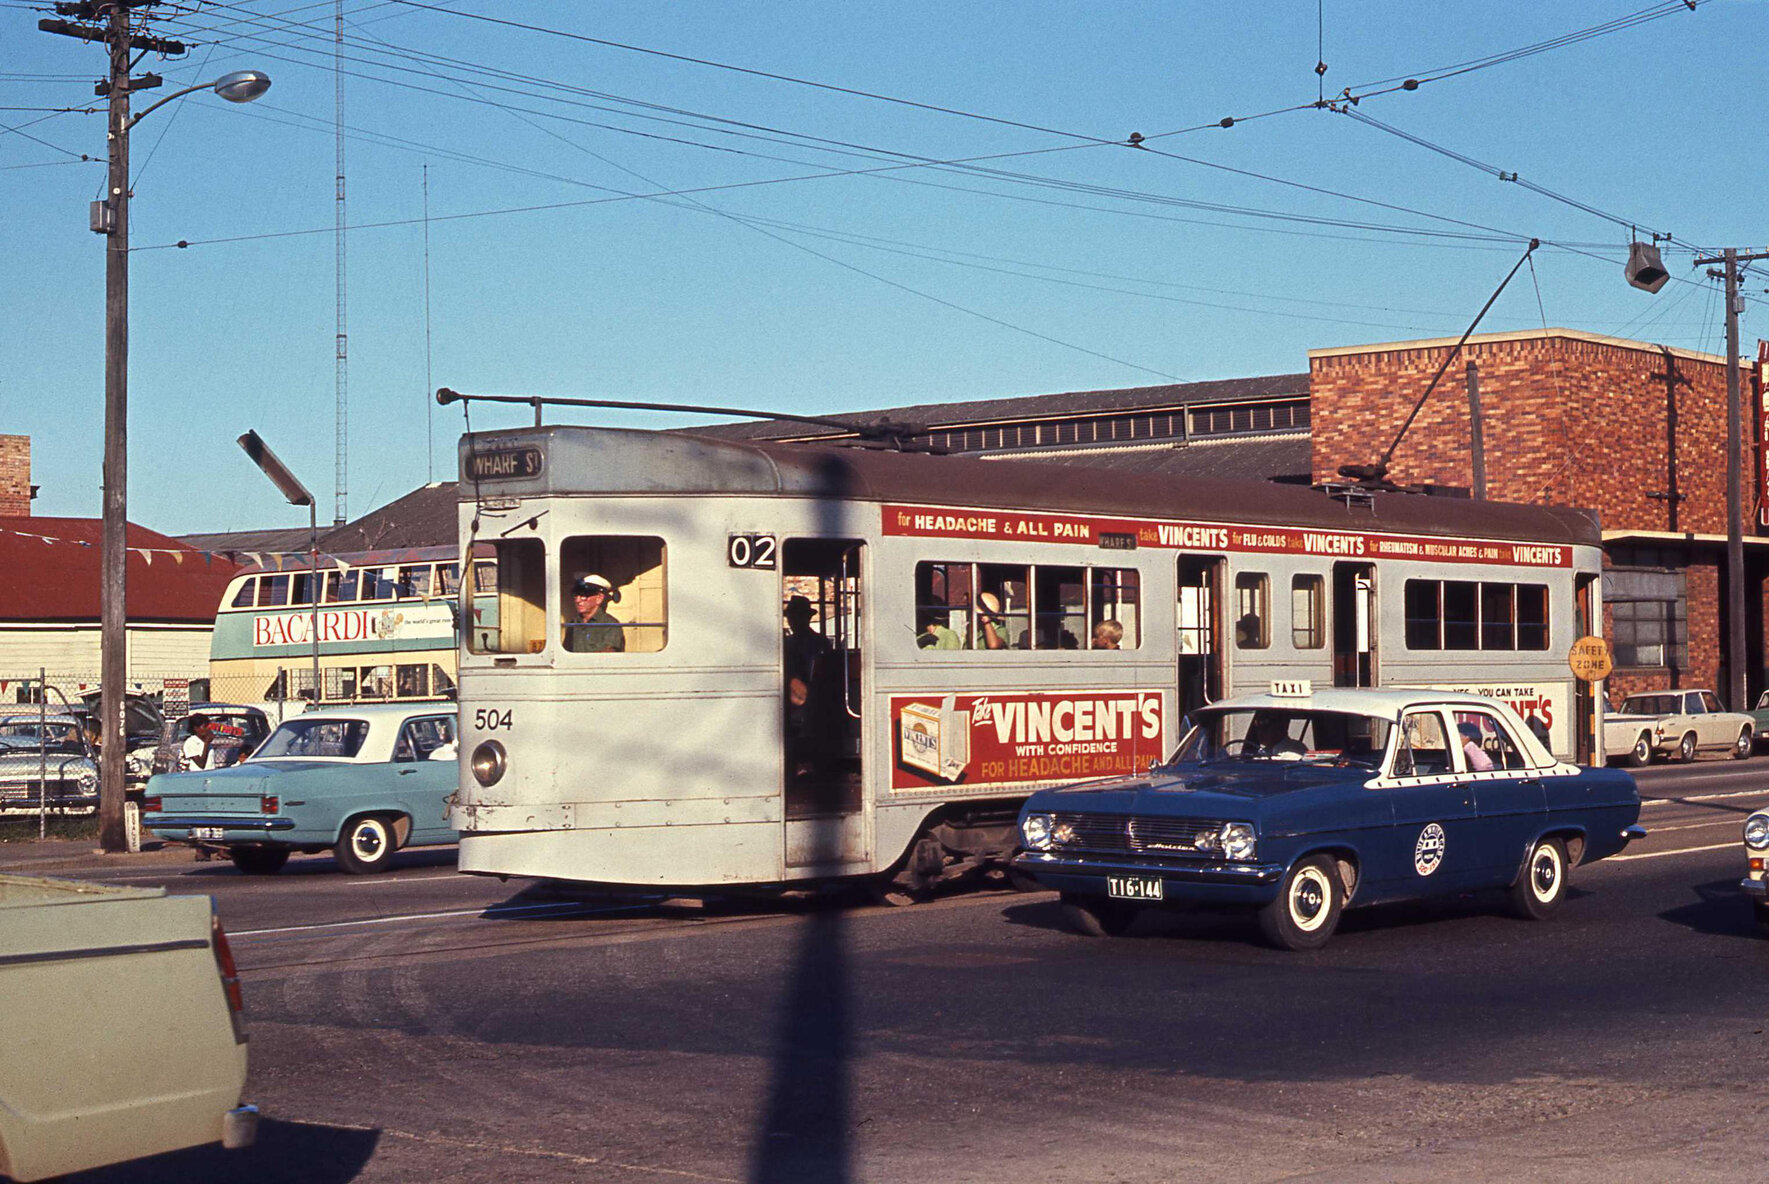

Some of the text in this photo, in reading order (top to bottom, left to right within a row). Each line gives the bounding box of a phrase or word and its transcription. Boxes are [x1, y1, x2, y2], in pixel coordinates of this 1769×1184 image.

[475, 454, 517, 474] WHARF
[898, 511, 1089, 538] for HEADACHE & ALL PAIN
[732, 537, 775, 565] 02
[1158, 525, 1228, 548] VINCENT'S
[1243, 533, 1256, 546] FLU
[1263, 535, 1285, 547] COLDS
[1303, 533, 1364, 555] VINCENT'S
[1425, 544, 1457, 557] MUSCULAR
[1458, 546, 1477, 558] ACHES
[1484, 547, 1498, 559] PAIN
[1512, 546, 1561, 564] VINCENT'S
[255, 611, 368, 645] BACARDI
[1576, 660, 1604, 669] ZONE
[1274, 683, 1302, 694] TAXI
[1478, 688, 1493, 697] YOU
[1496, 688, 1511, 697] CAN
[1514, 687, 1534, 696] TAKE
[475, 709, 513, 731] 504
[972, 697, 992, 724] Take
[992, 693, 1160, 744] VINCENT'S
[1016, 742, 1118, 757] WITH CONFIDENCE
[981, 762, 1004, 778] FOR
[1009, 756, 1090, 777] HEADACHE
[1094, 756, 1112, 771] AND
[1116, 755, 1132, 770] ALL
